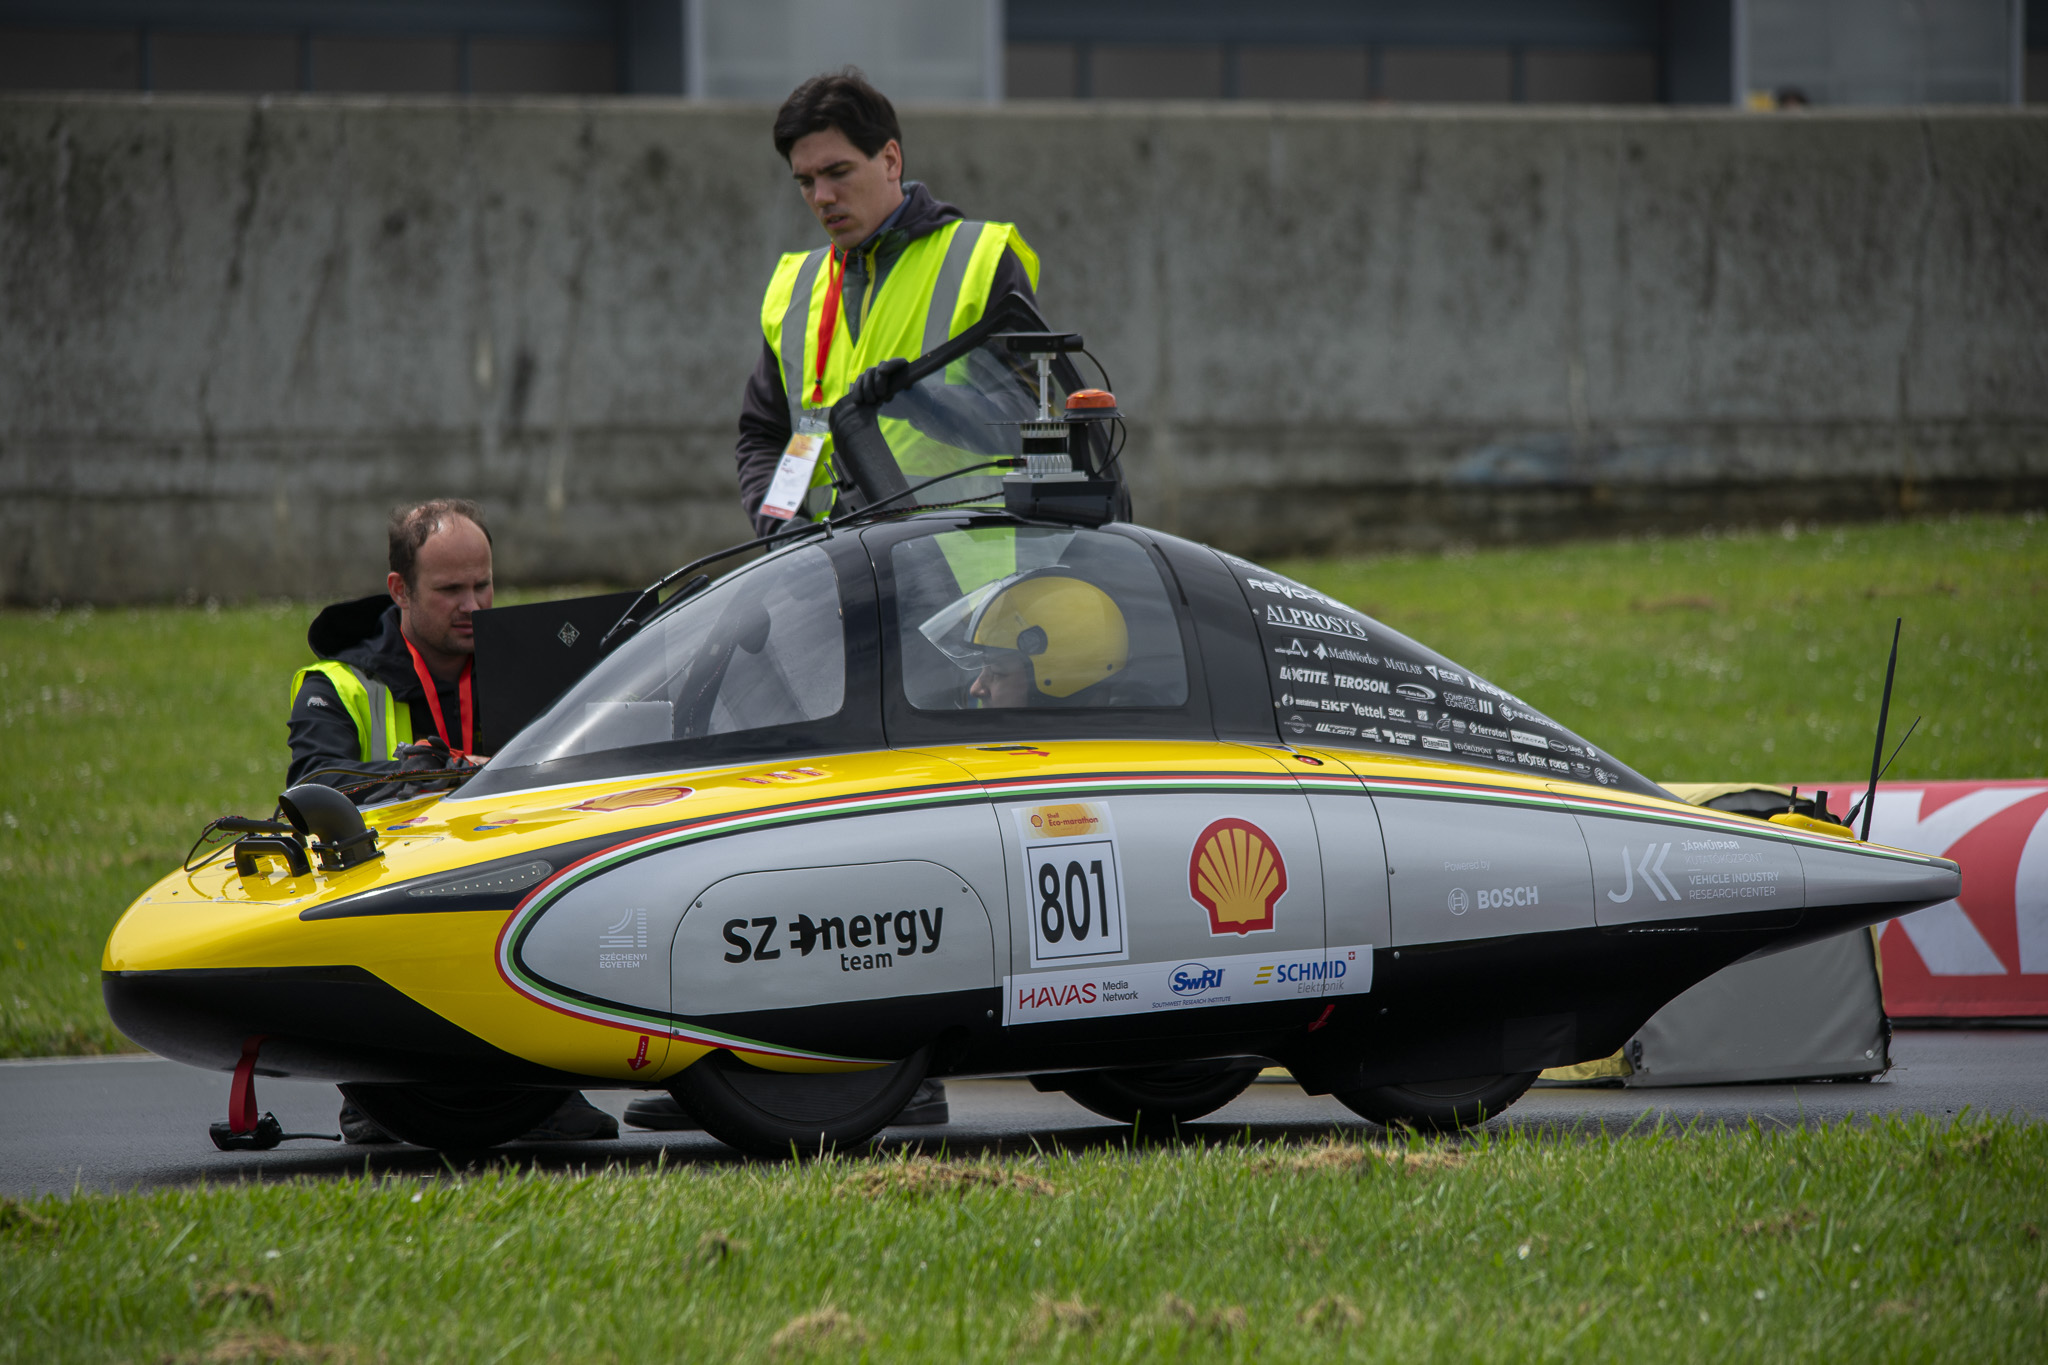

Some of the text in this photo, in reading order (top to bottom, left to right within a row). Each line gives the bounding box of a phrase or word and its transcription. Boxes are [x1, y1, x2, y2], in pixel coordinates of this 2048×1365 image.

[1267, 604, 1366, 637] ALPROSYS
[1328, 647, 1378, 665] MathWorks
[1280, 666, 1328, 685] LOCTITE
[1439, 669, 1463, 682] econ
[1334, 674, 1390, 694] TEROSON
[1443, 691, 1476, 704] COMPUTER
[1321, 700, 1350, 712] SKF
[1445, 699, 1478, 712] CONTROLS
[1388, 707, 1405, 718] SICK
[1395, 732, 1416, 741] POWER
[1477, 725, 1508, 739] ferroton
[1048, 816, 1099, 827] Eco-marathon
[1444, 859, 1491, 872] Powered by
[1689, 871, 1779, 885] VEHICLE INDUSTRY
[1477, 886, 1539, 909] BOSCH
[1689, 886, 1776, 900] RESEARCH CENTER
[1038, 860, 1109, 944] 801
[599, 951, 648, 961] SZÉCHENYI
[840, 952, 893, 972] team
[599, 960, 640, 969] EGYETEM
[1277, 960, 1347, 983] SCHMID
[1103, 980, 1129, 991] Media
[1297, 980, 1345, 995] Elektronik
[1018, 983, 1097, 1009] HAVAS
[1103, 990, 1139, 1002] Network
[1152, 996, 1231, 1009] SOUTHWEST RESEARCH INSTITUTE
